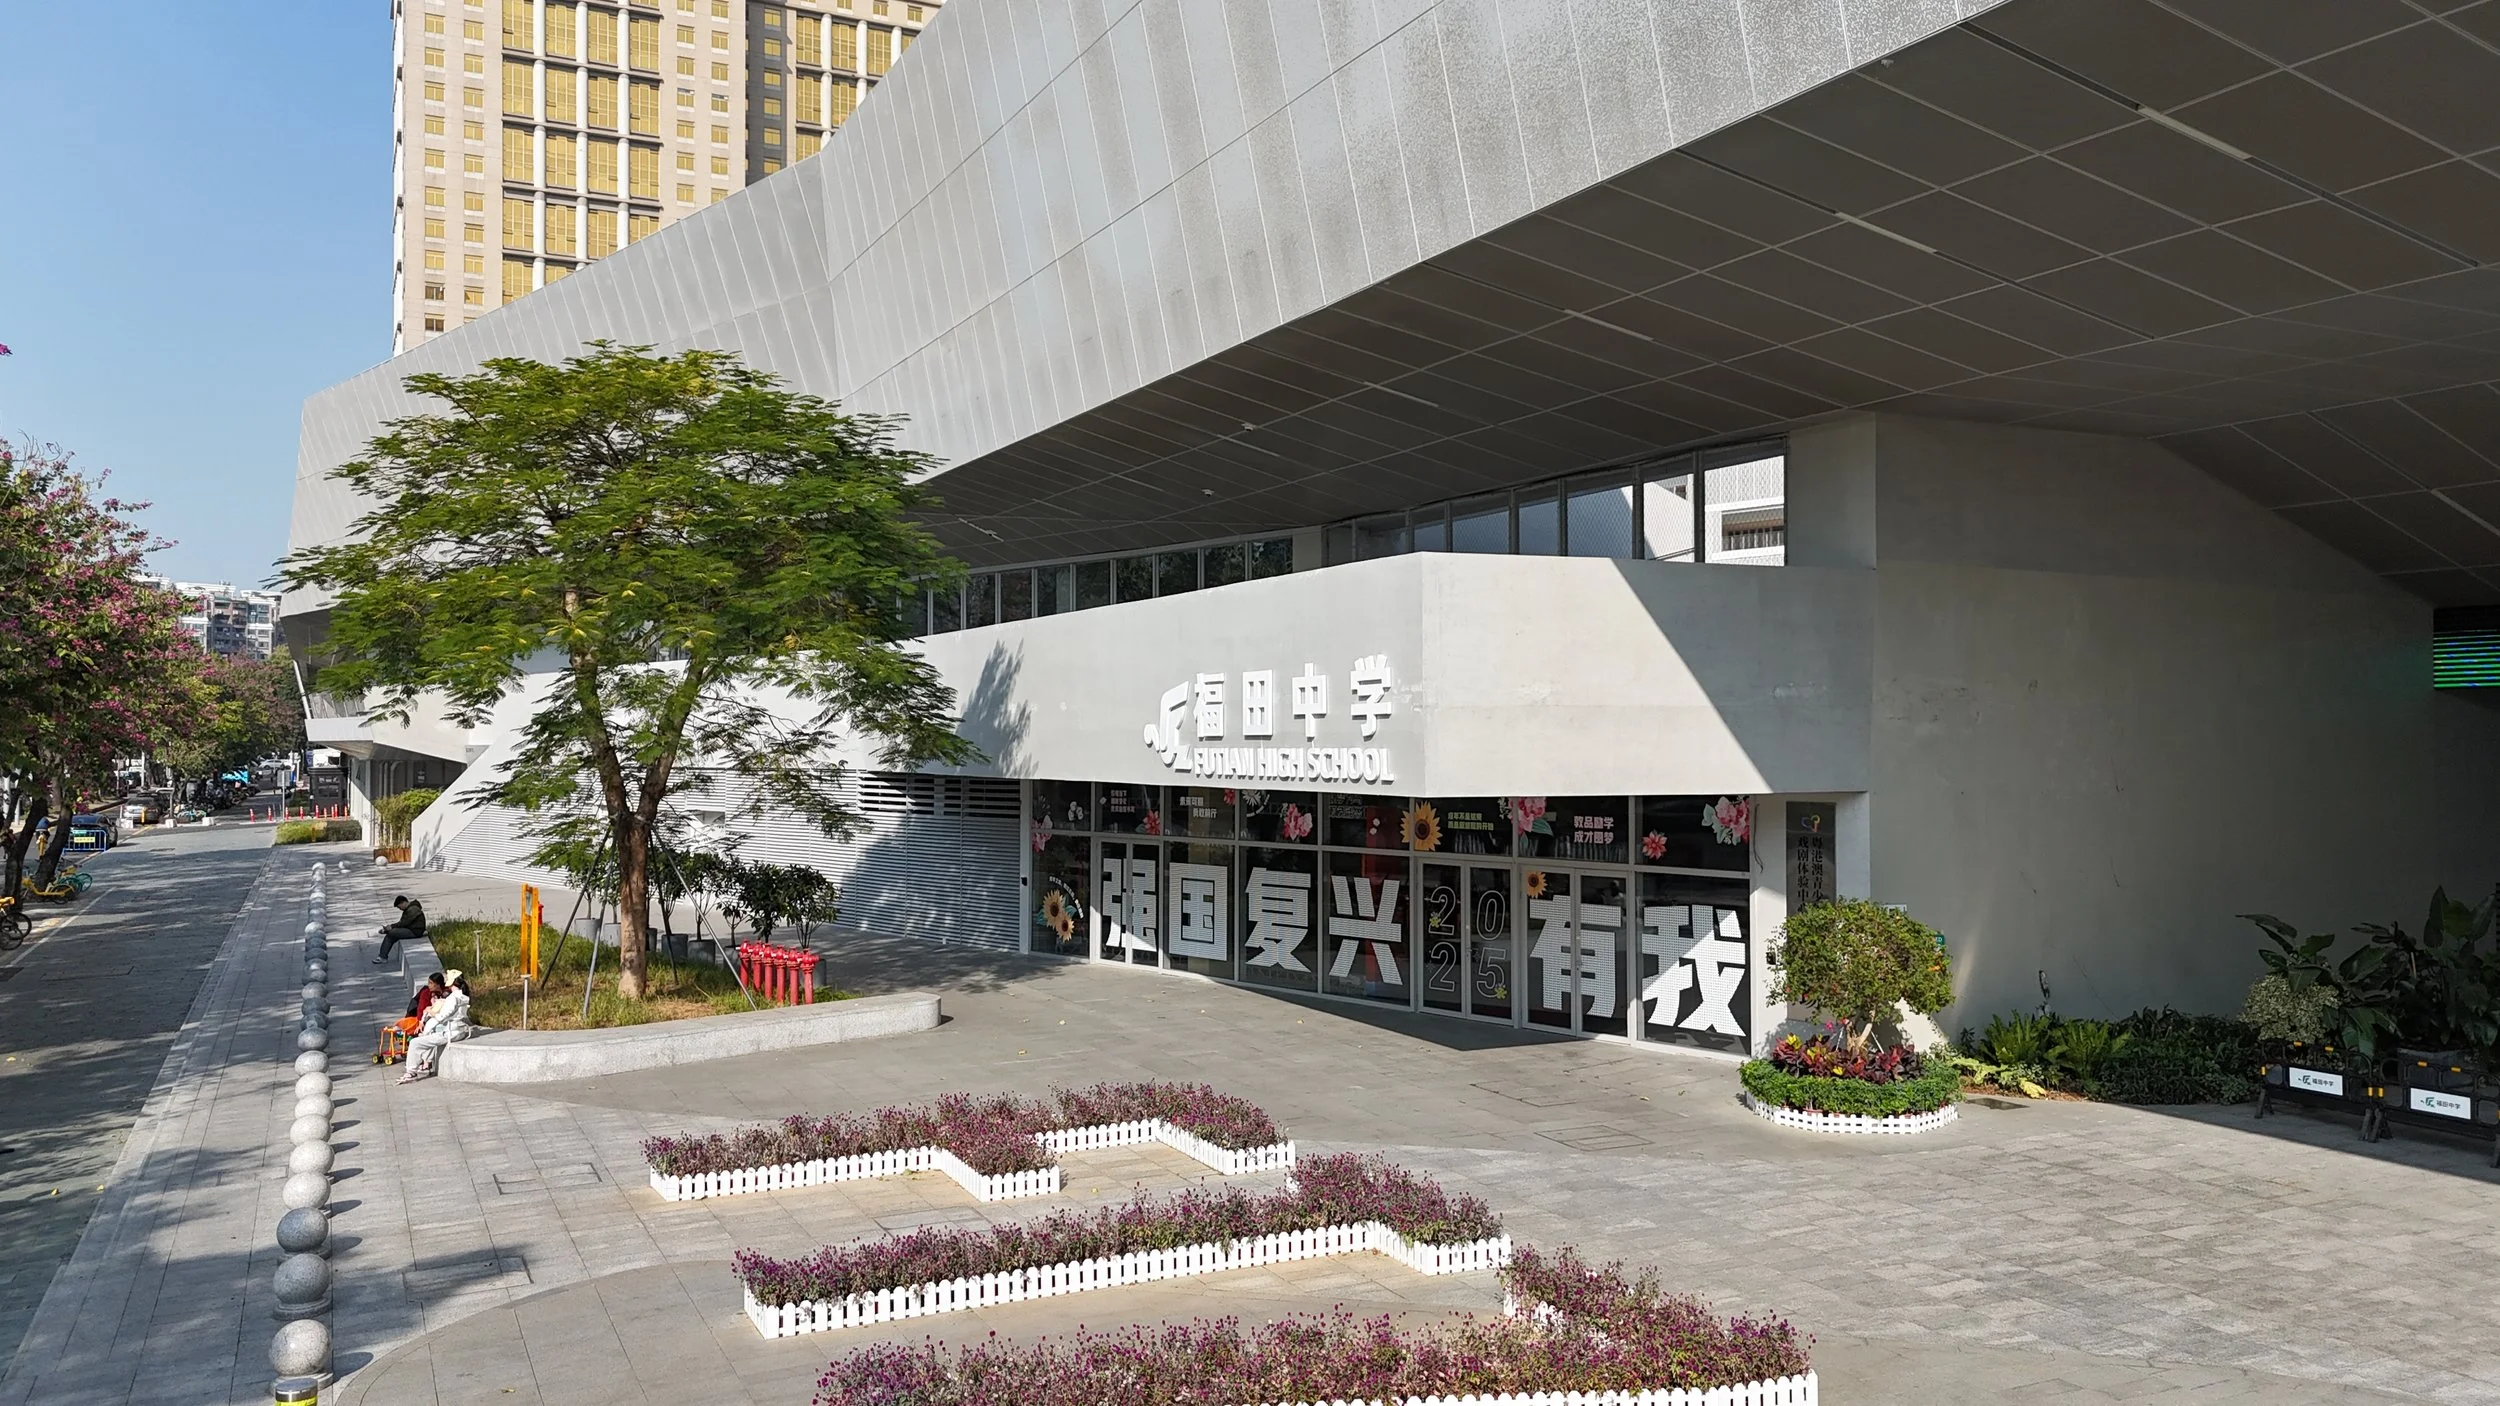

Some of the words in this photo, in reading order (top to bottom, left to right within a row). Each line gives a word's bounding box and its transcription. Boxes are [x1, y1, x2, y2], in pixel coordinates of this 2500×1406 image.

[1193, 654, 1392, 741] 福田中学
[1194, 747, 1255, 779] FUTIAN
[1257, 747, 1304, 781] HIGH
[1306, 747, 1395, 784] SCHOOL
[1573, 815, 1614, 830] 敦品励学
[1573, 830, 1614, 844] 成才圆梦
[1102, 858, 1403, 986] 强国复兴
[1429, 885, 1506, 941] 20
[1428, 941, 1508, 999] 25
[1529, 894, 1747, 1037] 有我
[2312, 1078, 2334, 1087] 福田中学
[2436, 1100, 2461, 1109] 福田中学
